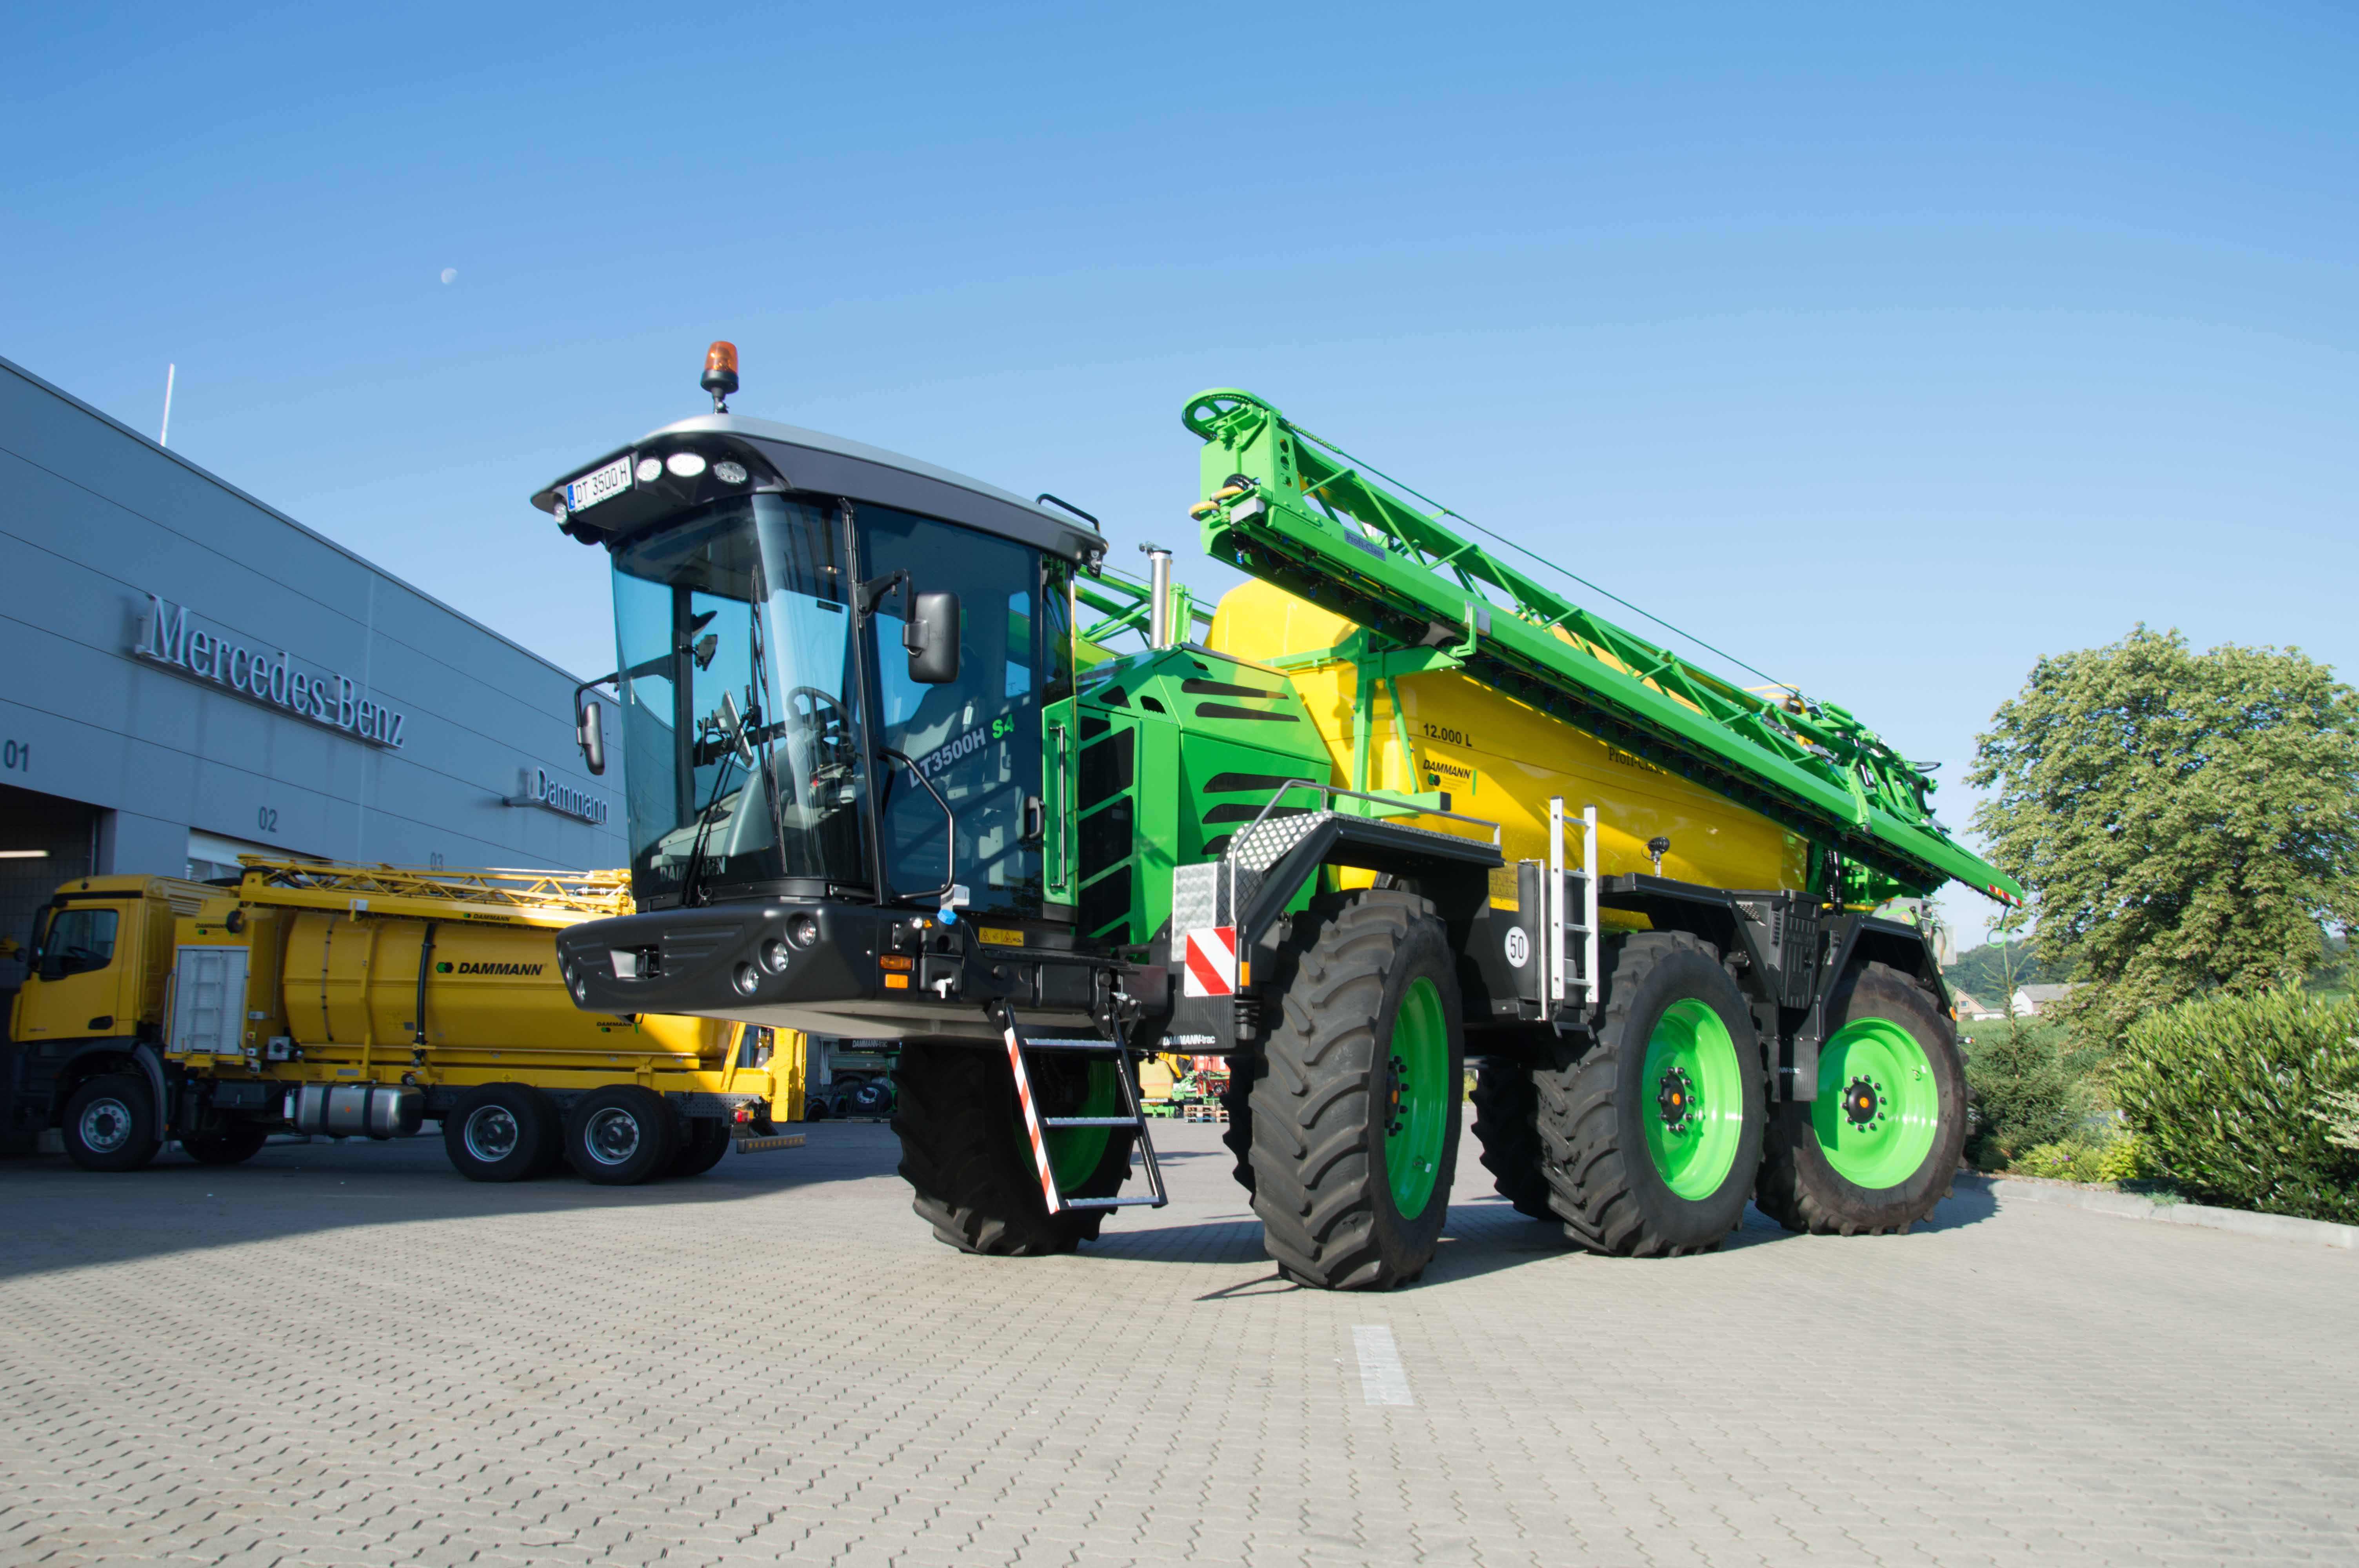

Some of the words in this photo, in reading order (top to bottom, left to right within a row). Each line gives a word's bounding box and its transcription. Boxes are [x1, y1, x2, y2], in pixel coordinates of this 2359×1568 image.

[576, 481, 588, 504] DT
[592, 468, 618, 495] 3500
[620, 463, 627, 485] H
[144, 593, 405, 749] Mercedes-Benz
[992, 713, 1015, 739] S4
[1423, 723, 1462, 744] 12.000
[1465, 733, 1472, 747] L
[4, 739, 30, 772] 01
[1423, 759, 1471, 779] DAMMANN
[533, 766, 608, 825] Dammann
[258, 806, 277, 833] 02
[473, 913, 511, 922] DAMMANN
[1510, 935, 1524, 959] 50
[458, 963, 543, 976] DAMMANN
